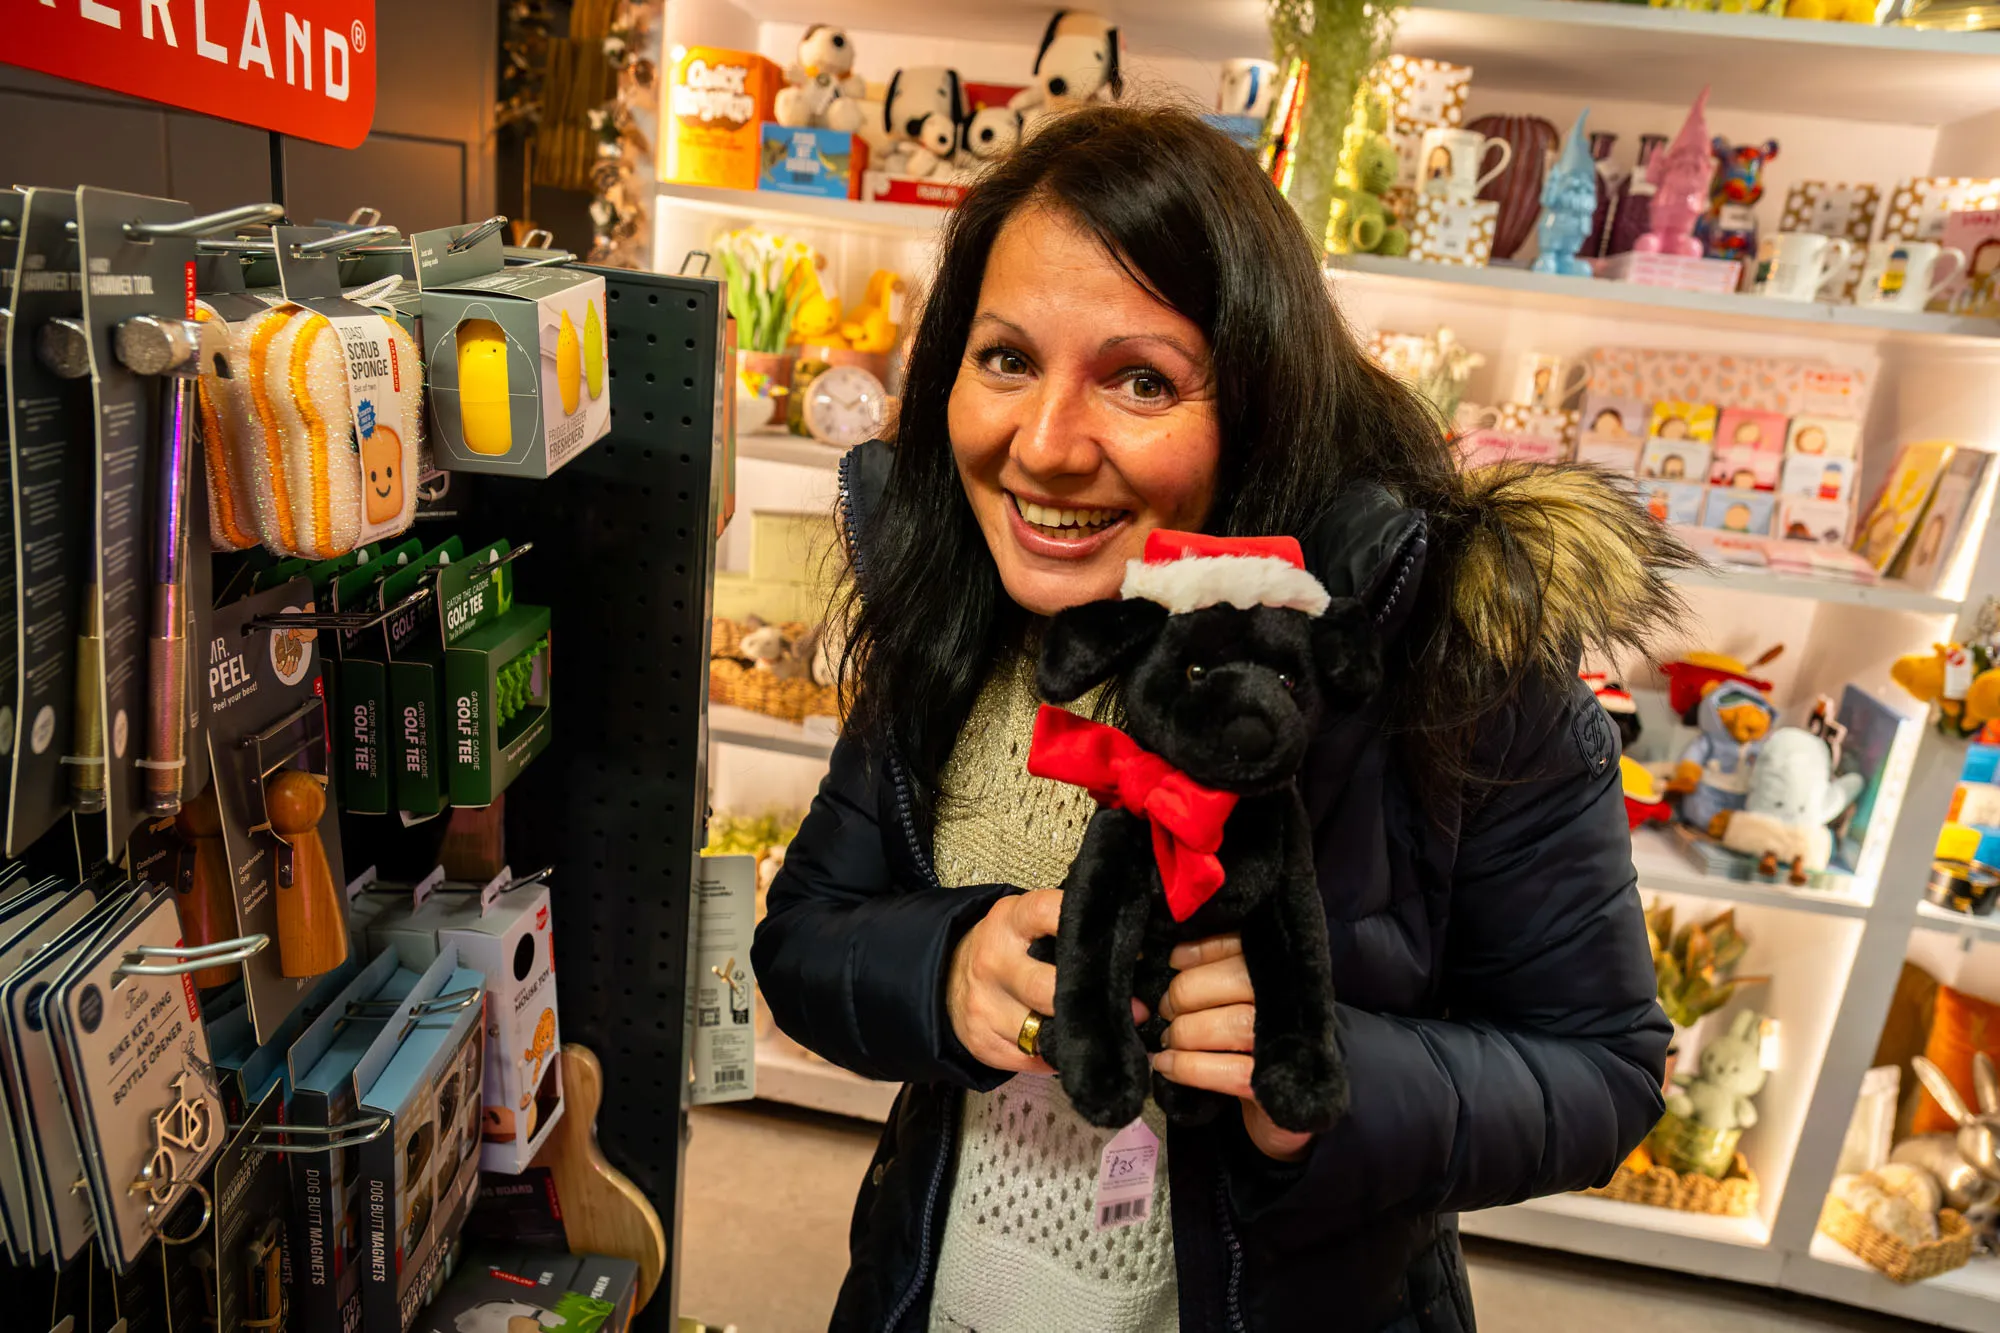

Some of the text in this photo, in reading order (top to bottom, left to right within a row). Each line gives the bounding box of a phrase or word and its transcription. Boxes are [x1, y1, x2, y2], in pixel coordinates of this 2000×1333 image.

[339, 326, 367, 340] TOAST
[347, 340, 380, 361] SCRUB
[351, 358, 389, 381] SPONGE
[446, 593, 462, 610] GATOR
[472, 577, 489, 595] CADDIE
[447, 600, 469, 630] GOLF
[469, 591, 484, 617] TEE
[391, 610, 416, 641] GOLF
[209, 653, 251, 699] PEEL
[212, 680, 257, 713] Peel your best!
[368, 699, 376, 727] GATOR
[470, 690, 479, 719] GATOR
[353, 704, 369, 771] GOLF TEE
[403, 706, 420, 772] GOLF TEE
[417, 700, 429, 780] GATOR THE CADDIE
[456, 696, 473, 764] GOLF TEE
[369, 748, 377, 779] CADDIE
[472, 739, 480, 771] CADDIE
[108, 1034, 131, 1066] BIKE
[131, 1013, 149, 1041] KEY
[150, 990, 172, 1021] RING
[136, 1031, 155, 1058] AND
[113, 1059, 149, 1106] BOTTLE
[148, 1020, 182, 1065] OPENER
[221, 1166, 251, 1217] HAMMER
[305, 1167, 326, 1286] DOG BUTT MAGNETS
[369, 1179, 386, 1282] DOG BUTT MAGNETS
